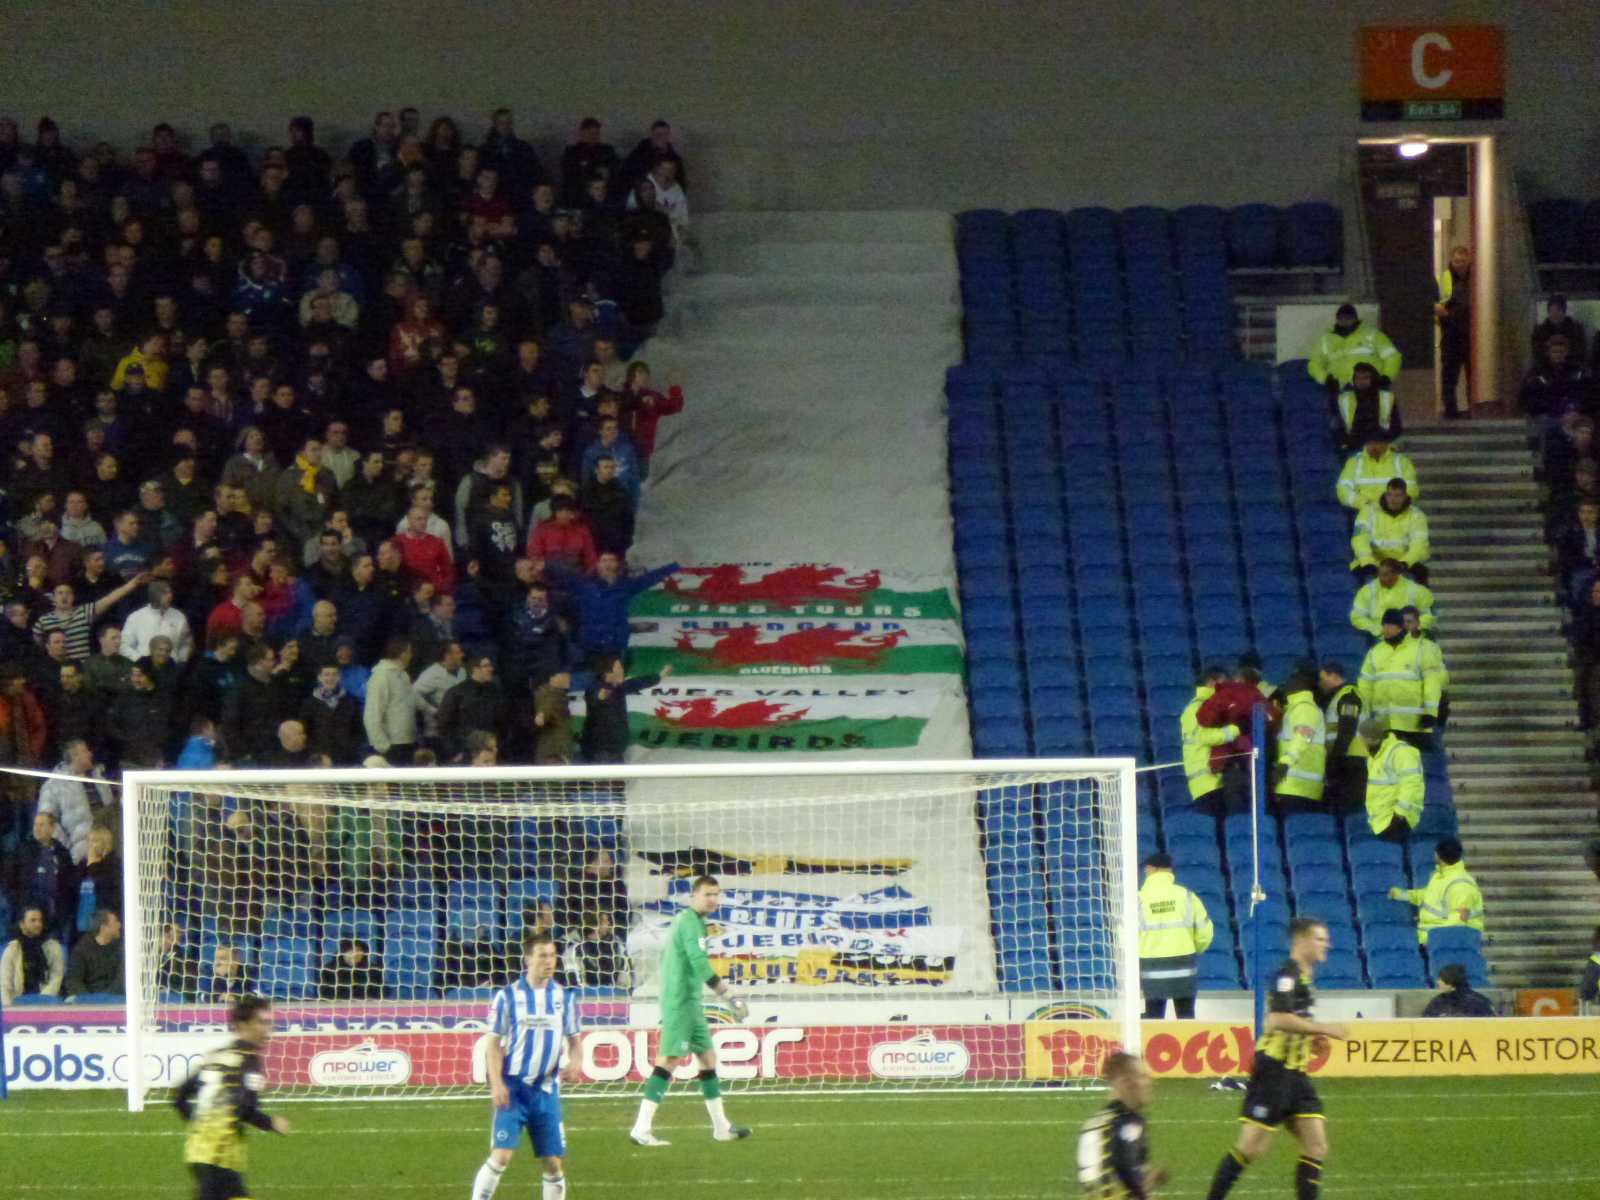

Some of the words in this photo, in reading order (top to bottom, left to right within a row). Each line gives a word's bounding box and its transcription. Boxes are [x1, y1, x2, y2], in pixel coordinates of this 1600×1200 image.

[1412, 32, 1453, 89] C
[755, 688, 916, 697] VALLEY
[1346, 1038, 1477, 1063] PIZZERIA
[1496, 1036, 1600, 1062] RISTOR
[882, 1051, 957, 1064] npower
[323, 1060, 397, 1073] npower
